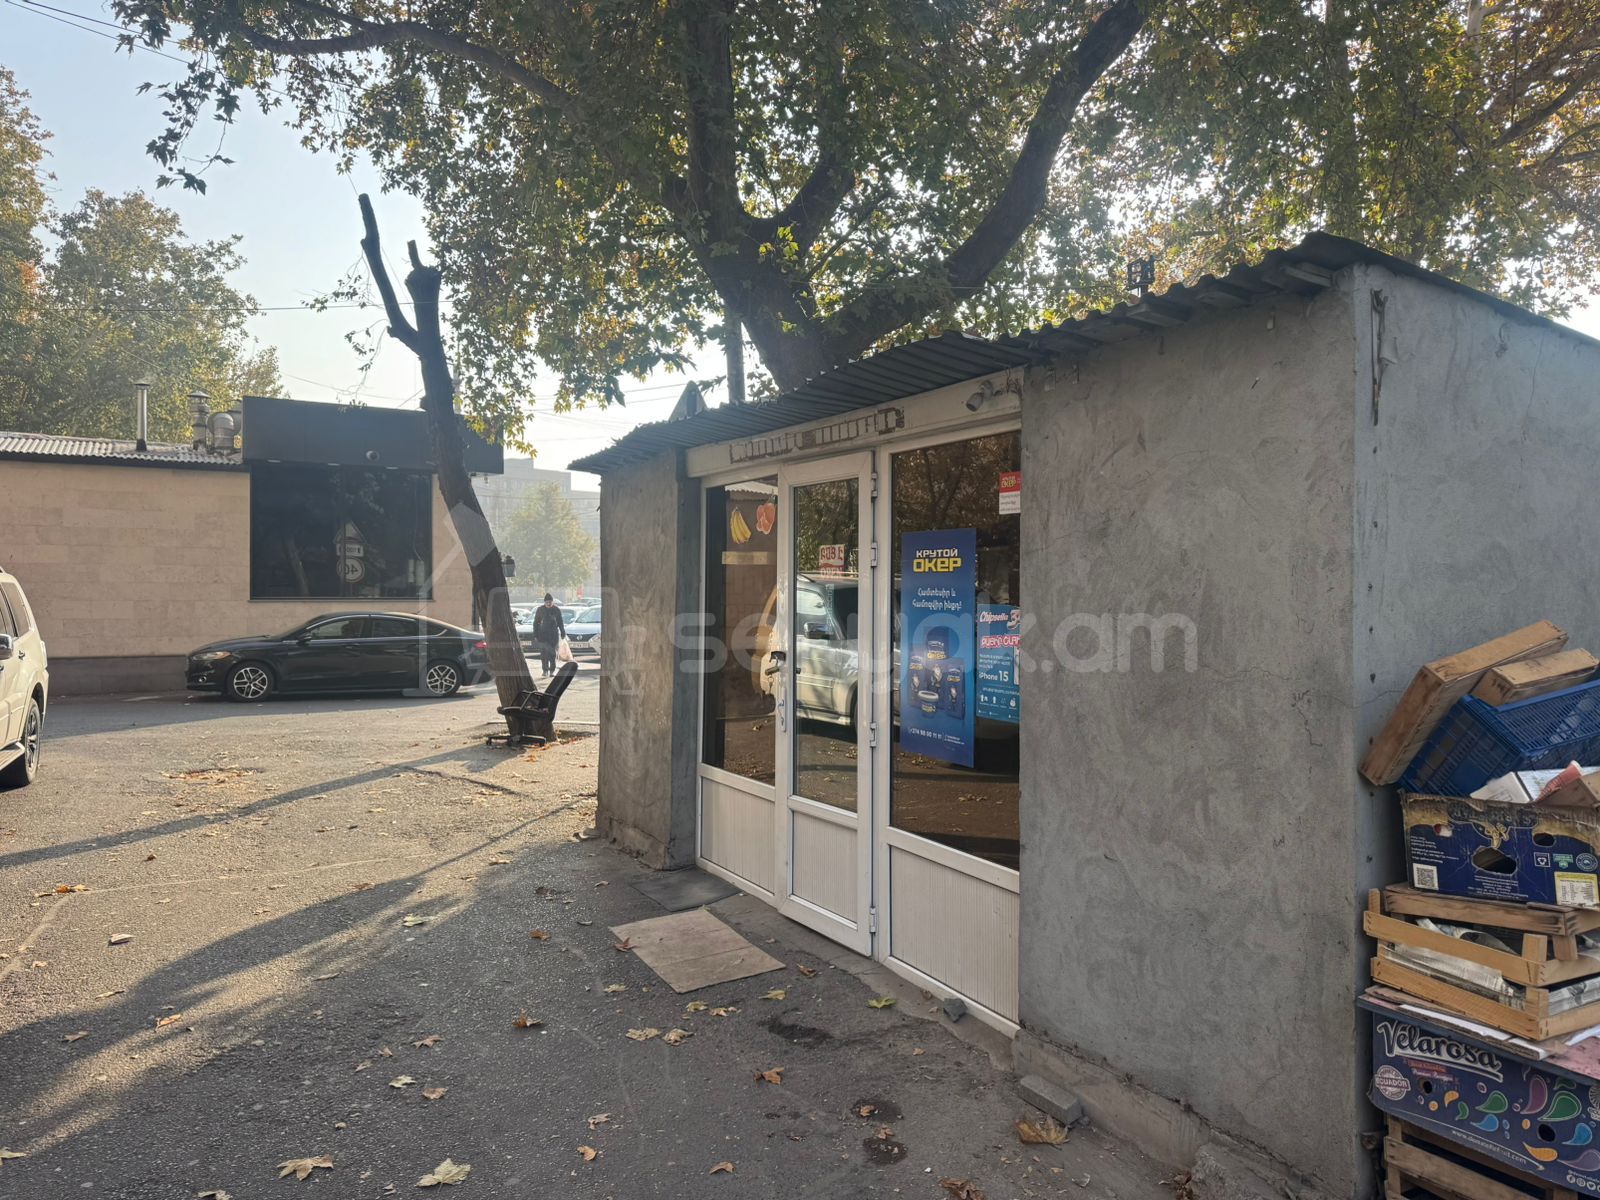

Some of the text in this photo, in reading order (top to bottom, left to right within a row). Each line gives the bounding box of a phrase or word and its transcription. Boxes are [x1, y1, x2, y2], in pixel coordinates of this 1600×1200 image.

[916, 548, 958, 558] КРУТОЙ
[913, 558, 962, 572] ОКЕР
[979, 670, 1009, 682] iPhone 15
[1376, 1077, 1408, 1088] ECUADOR
